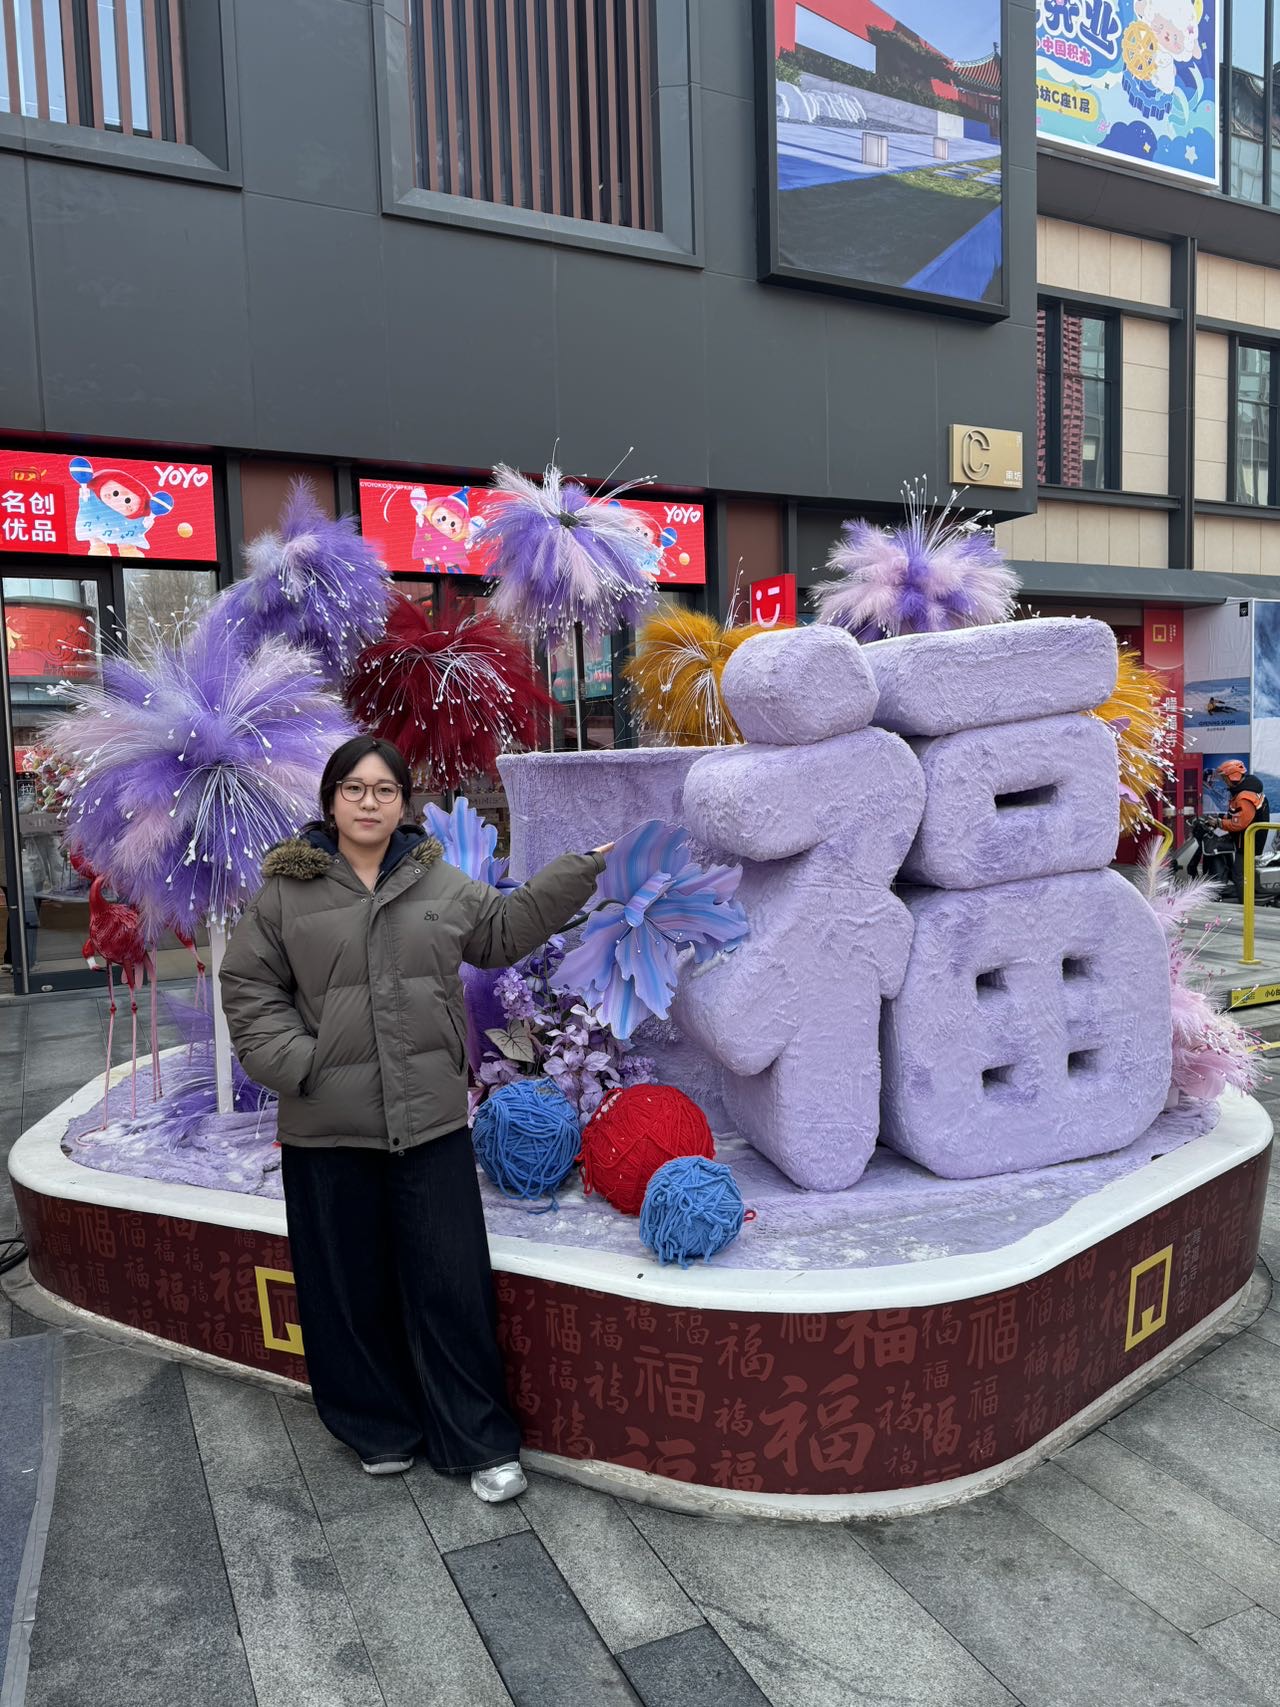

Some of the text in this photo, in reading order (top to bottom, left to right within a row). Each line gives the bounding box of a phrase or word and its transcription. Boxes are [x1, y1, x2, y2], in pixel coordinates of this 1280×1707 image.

[1037, 0, 1119, 56] 开业
[1042, 36, 1091, 66] 中国积木
[962, 429, 991, 481] C
[1, 489, 55, 515] 名创
[2, 517, 57, 542] 优品
[153, 1237, 175, 1264] 福
[590, 1313, 623, 1350] 福
[715, 1322, 775, 1381] 福
[549, 1356, 578, 1392] 福
[634, 1345, 706, 1423] 福
[923, 1360, 949, 1391] 福
[759, 1374, 876, 1477] 福
